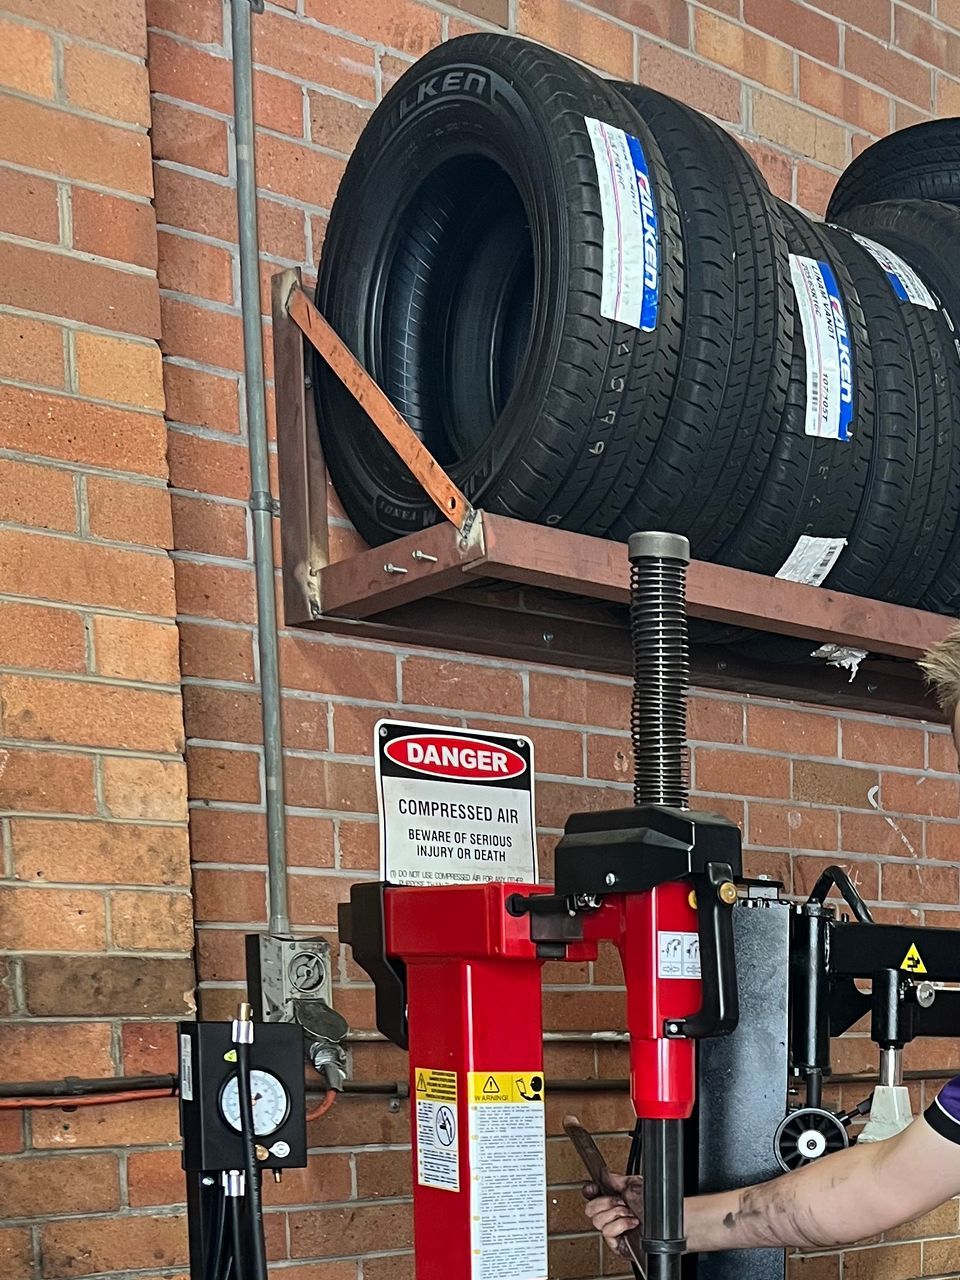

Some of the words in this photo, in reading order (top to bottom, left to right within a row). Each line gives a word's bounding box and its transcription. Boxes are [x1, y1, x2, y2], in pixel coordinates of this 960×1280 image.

[636, 168, 658, 290] FALKEN
[811, 264, 828, 300] LINAM
[829, 295, 852, 403] FALKEN
[406, 742, 509, 773] DANGER
[398, 799, 493, 822] COMPRESSED
[497, 808, 519, 824] AIR
[408, 828, 451, 843] BEWARE
[454, 832, 467, 844] OF
[469, 833, 513, 848] SERIOUS
[416, 844, 456, 858] INJURY
[457, 848, 471, 860] OR
[474, 849, 506, 862] DEATH
[398, 870, 408, 878] DO
[409, 870, 421, 878] NOT
[422, 871, 433, 879] USE
[435, 872, 471, 881] COMPRESSED
